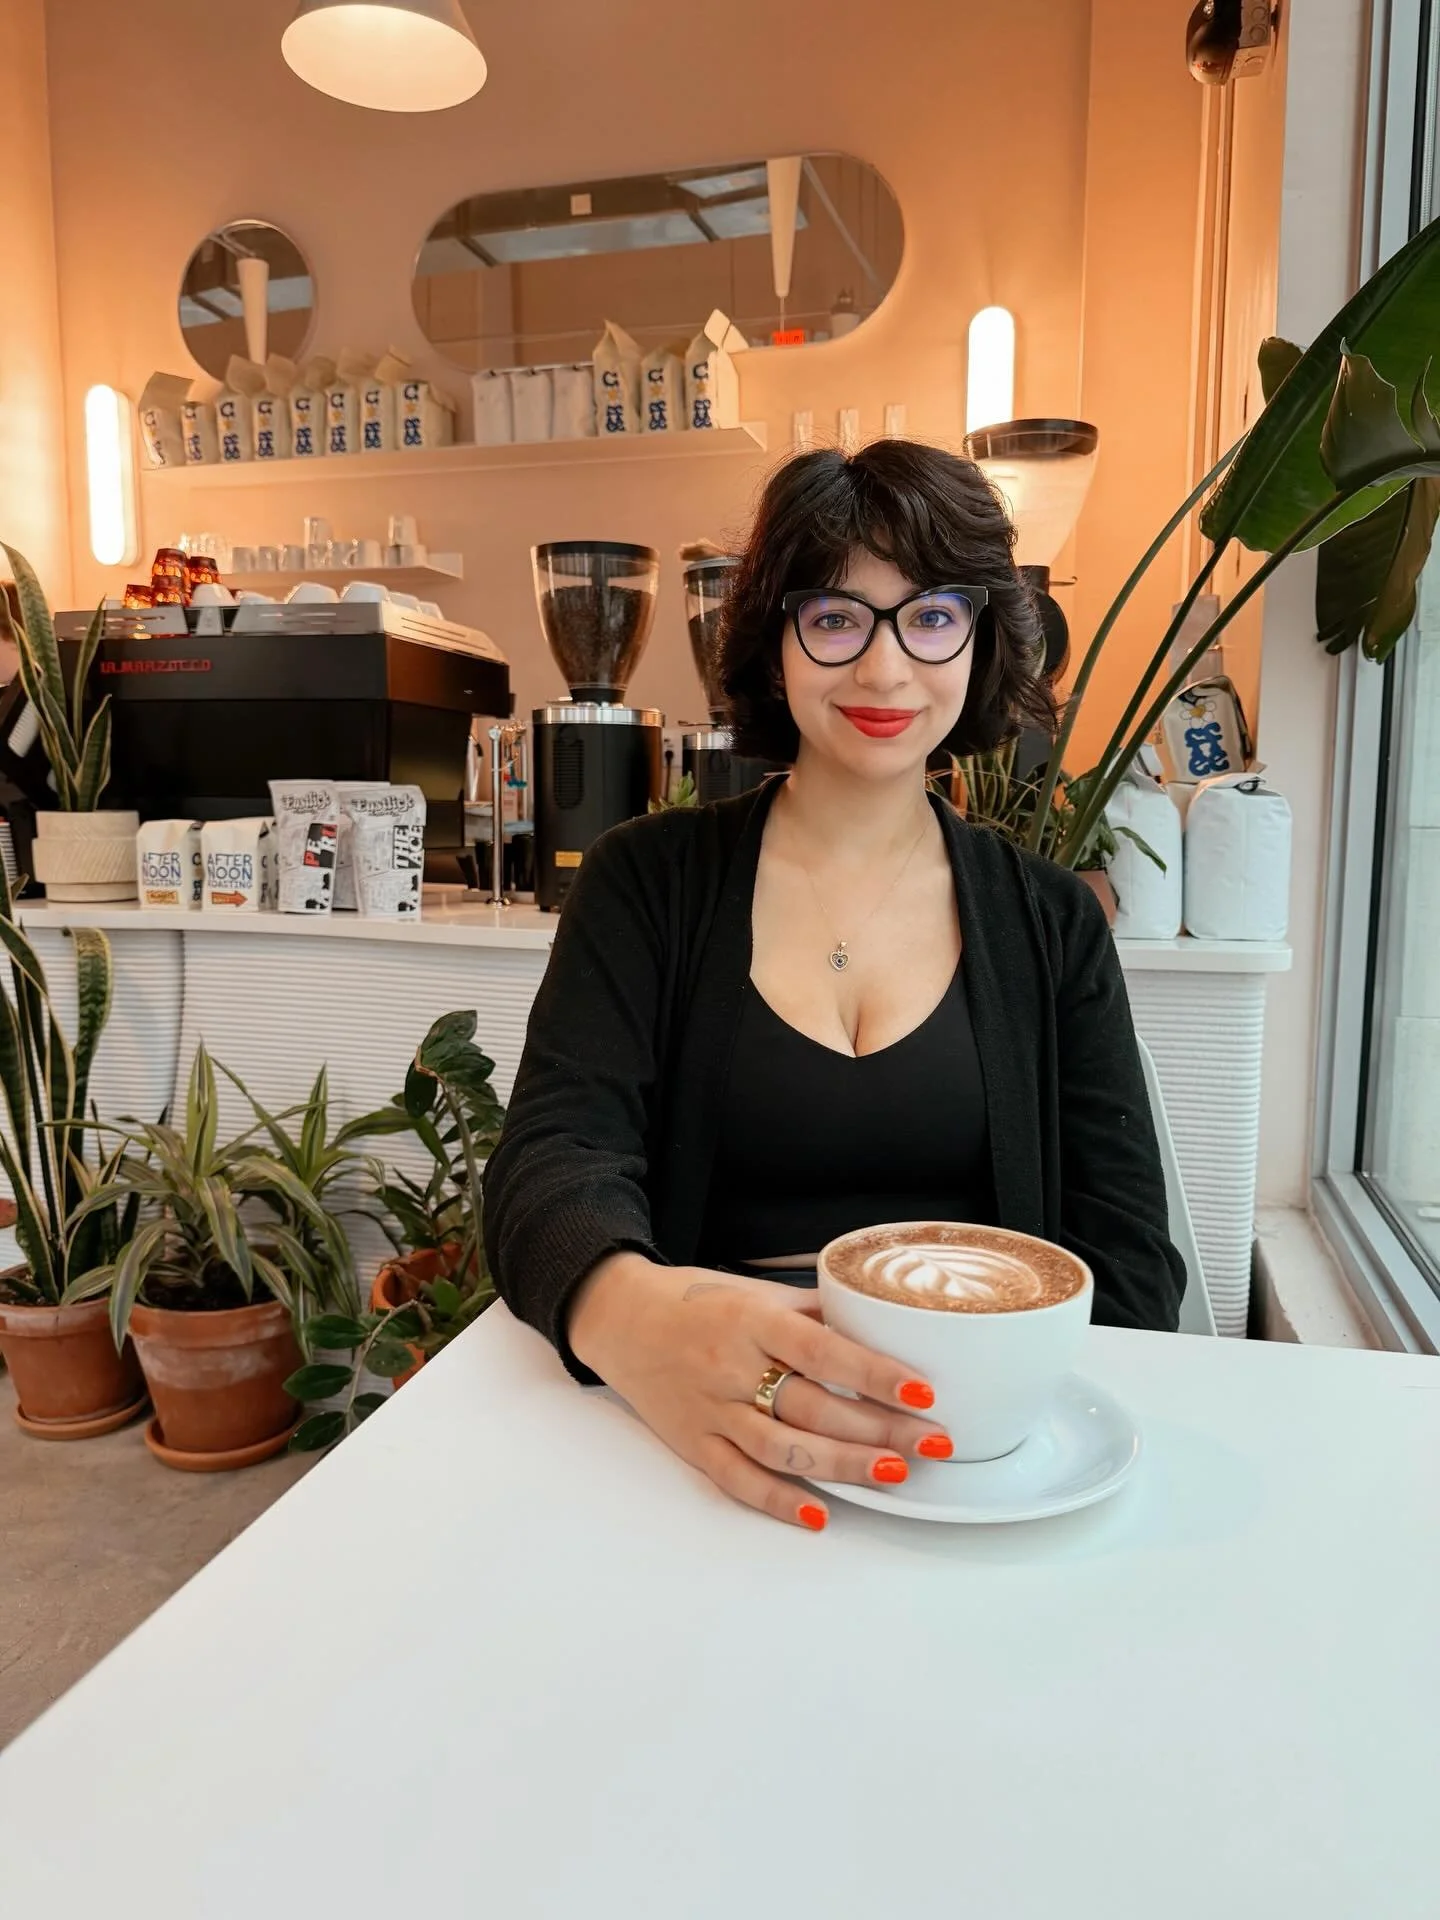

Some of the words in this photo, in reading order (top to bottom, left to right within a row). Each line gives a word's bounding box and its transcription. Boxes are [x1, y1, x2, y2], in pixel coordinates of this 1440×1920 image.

[394, 826, 409, 869] THE
[142, 851, 181, 866] AFTER
[207, 853, 252, 866] AFTER
[142, 864, 181, 878] NOON
[207, 866, 253, 880] NOON
